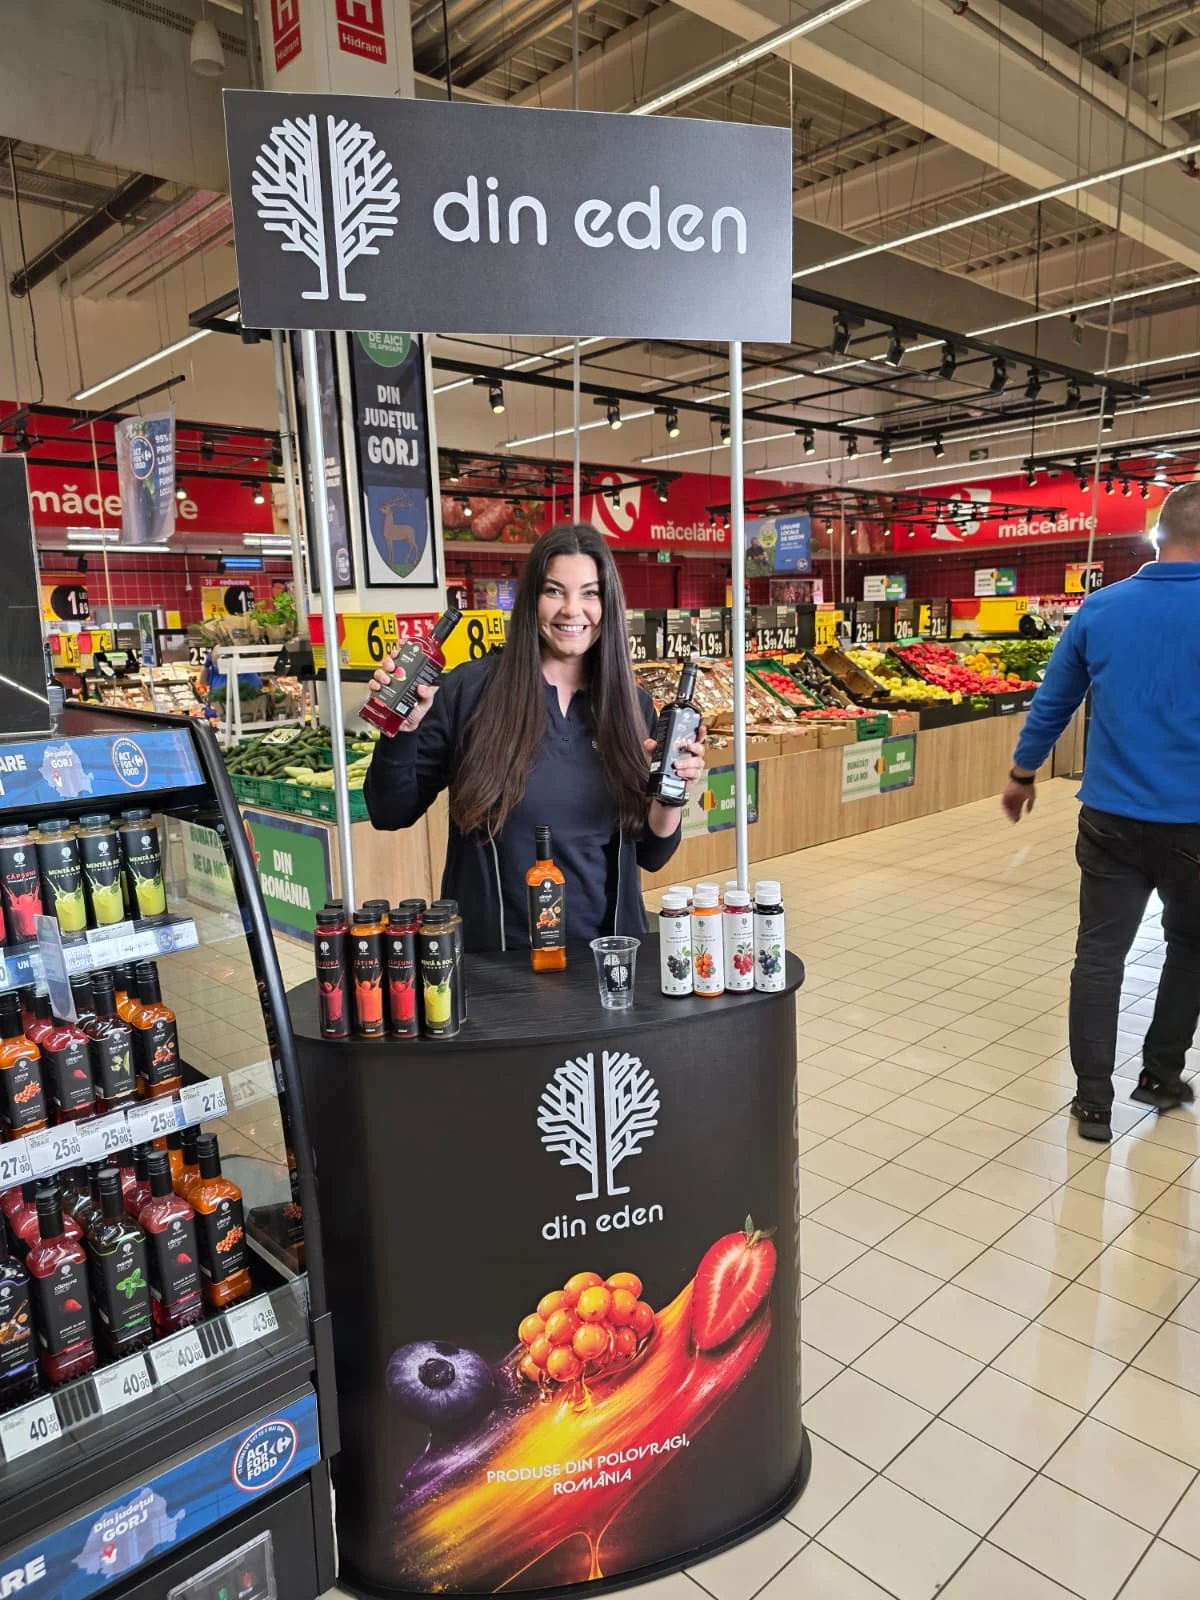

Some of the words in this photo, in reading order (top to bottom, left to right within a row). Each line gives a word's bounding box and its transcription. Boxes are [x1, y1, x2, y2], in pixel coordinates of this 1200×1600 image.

[342, 33, 383, 56] Hidrant
[433, 175, 547, 246] din
[574, 184, 747, 254] eden
[377, 385, 401, 405] DIN
[368, 435, 419, 467] GORJ
[651, 521, 725, 542] măcelărie
[998, 513, 1098, 538] măcelărie
[368, 620, 383, 662] 6
[383, 617, 396, 635] LEI
[467, 618, 487, 660] 8
[487, 617, 504, 635] LEI
[51, 758, 73, 769] GORJ
[119, 751, 130, 761] ACT
[123, 767, 140, 777] FOOD
[272, 849, 293, 876] DIN
[261, 874, 311, 911] ROMÂNIA
[202, 1094, 217, 1112] 27
[216, 1091, 224, 1099] LEI
[217, 1099, 226, 1107] 00
[151, 1113, 167, 1132] 25
[165, 1111, 174, 1119] LEI
[167, 1118, 176, 1128] 00
[69, 1136, 79, 1146] LEI
[102, 1131, 117, 1150] 25
[117, 1127, 127, 1136] LEI
[119, 1134, 129, 1144] 00
[18, 1153, 27, 1163] LEI
[52, 1140, 69, 1161] 25
[71, 1144, 81, 1154] 00
[1, 1159, 18, 1180] 27
[20, 1163, 30, 1174] 00
[542, 1215, 586, 1240] din
[596, 1204, 664, 1232] eden
[252, 1312, 267, 1332] 43
[178, 1344, 194, 1366] 40
[193, 1350, 204, 1361] 00
[123, 1373, 140, 1396] 40
[137, 1371, 147, 1380] LEI
[139, 1379, 150, 1391] 00
[46, 1412, 56, 1423] LEI
[29, 1416, 48, 1441] 40
[48, 1422, 59, 1434] 00
[247, 1440, 269, 1461] ACT
[486, 1463, 561, 1485] PRODUSE
[564, 1457, 593, 1475] DIN
[597, 1432, 690, 1468] POLOVRAGI,
[247, 1452, 268, 1471] FOR
[248, 1456, 278, 1481] FOOD
[552, 1467, 632, 1496] ROMÂNIA
[94, 1516, 114, 1535] Din
[102, 1508, 148, 1542] GORJ
